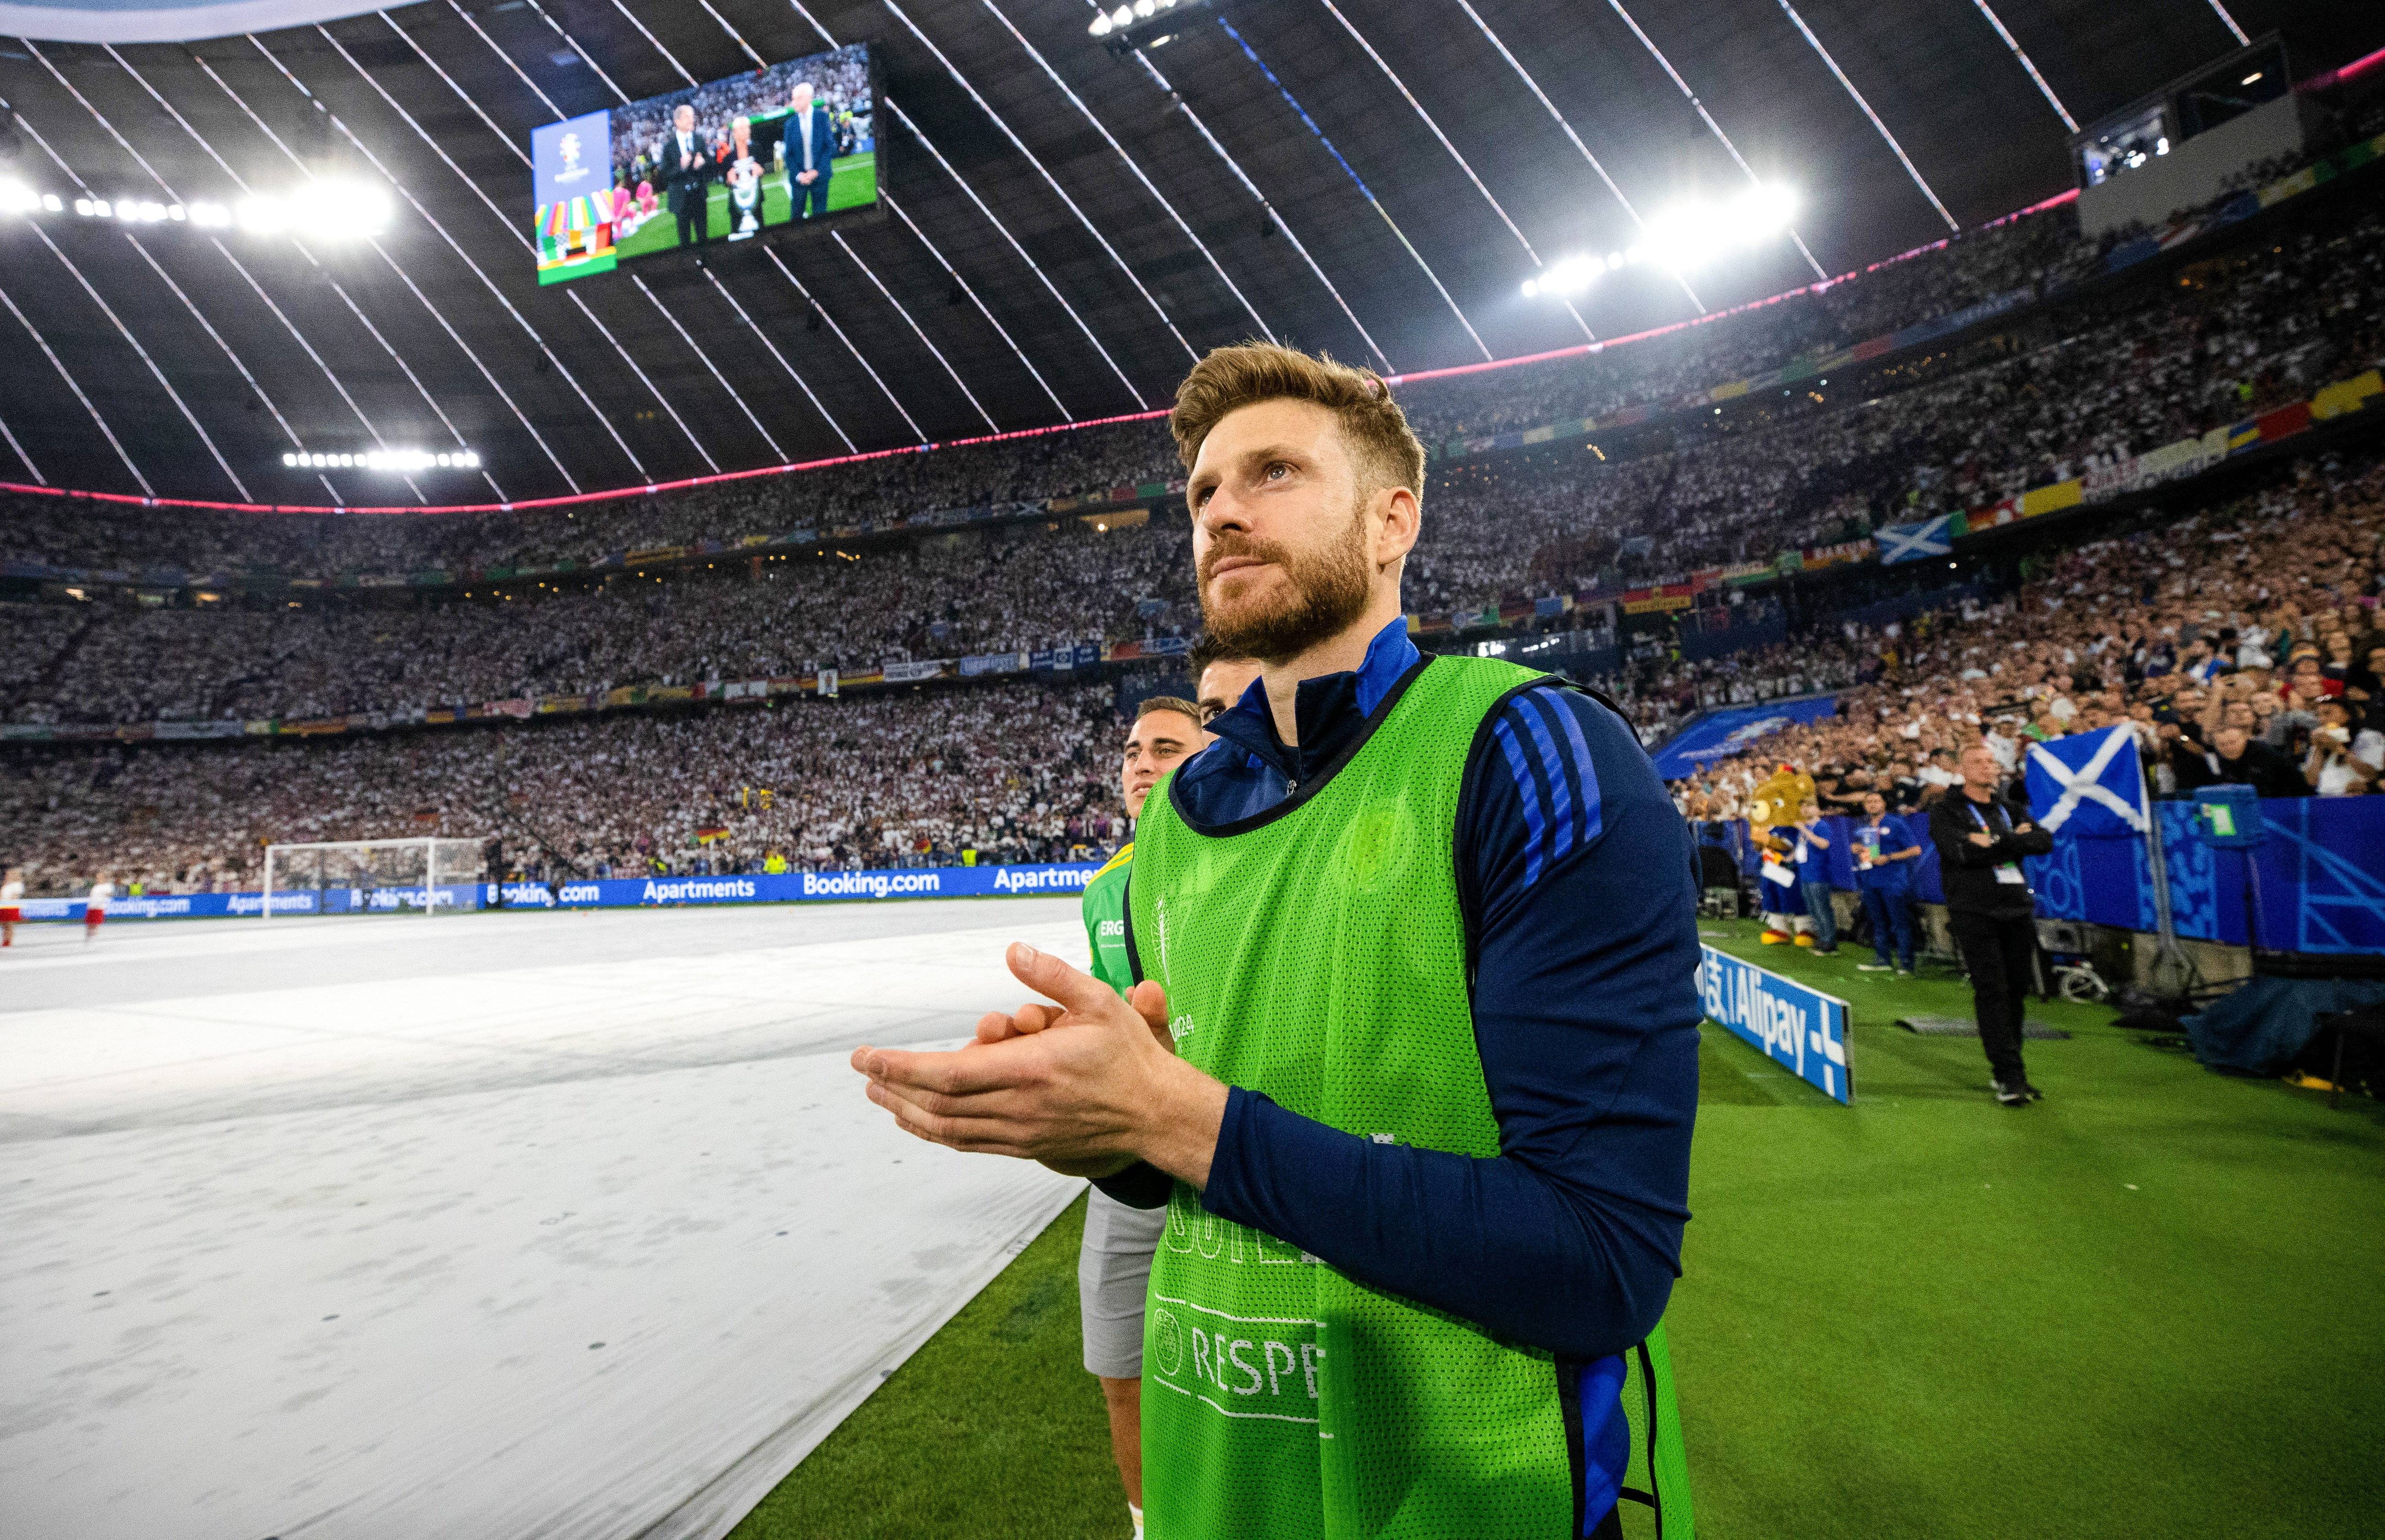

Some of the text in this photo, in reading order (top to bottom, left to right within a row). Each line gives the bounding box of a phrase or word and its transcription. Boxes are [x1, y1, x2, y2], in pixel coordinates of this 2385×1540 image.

[226, 894, 313, 915] Aparments
[643, 879, 756, 904] Apartments
[803, 871, 940, 898] Booking.com
